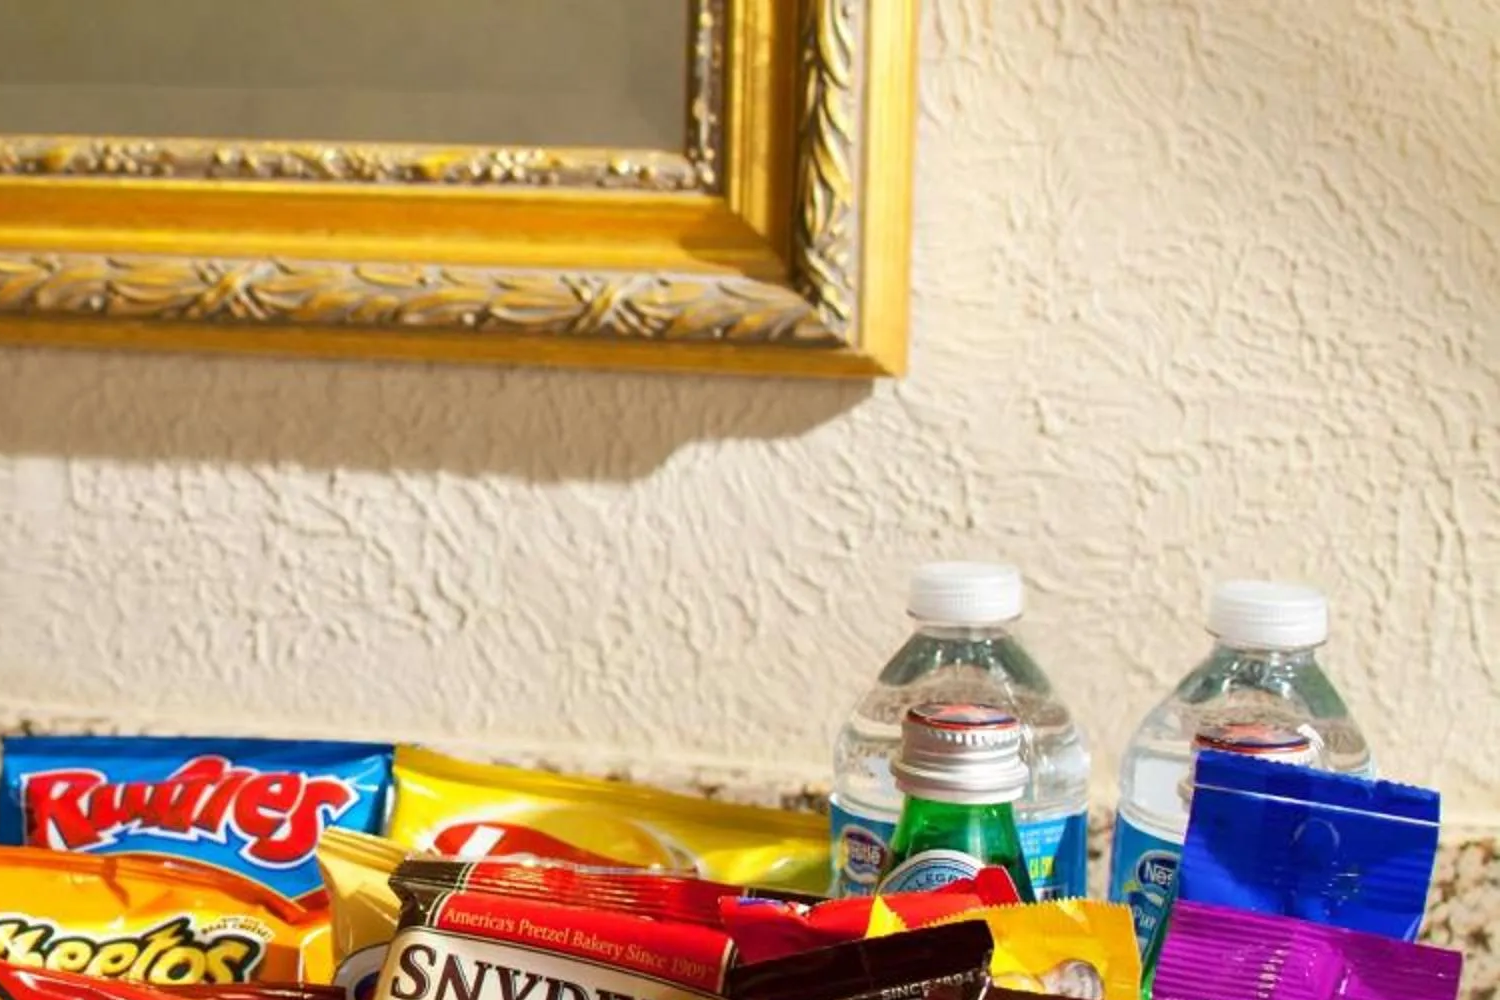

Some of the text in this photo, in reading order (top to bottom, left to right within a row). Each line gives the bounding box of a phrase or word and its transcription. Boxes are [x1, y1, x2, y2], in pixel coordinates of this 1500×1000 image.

[22, 756, 360, 868] Ruffles
[518, 916, 570, 945] Pretzel
[571, 930, 625, 960] Bakery
[626, 943, 666, 969] Since
